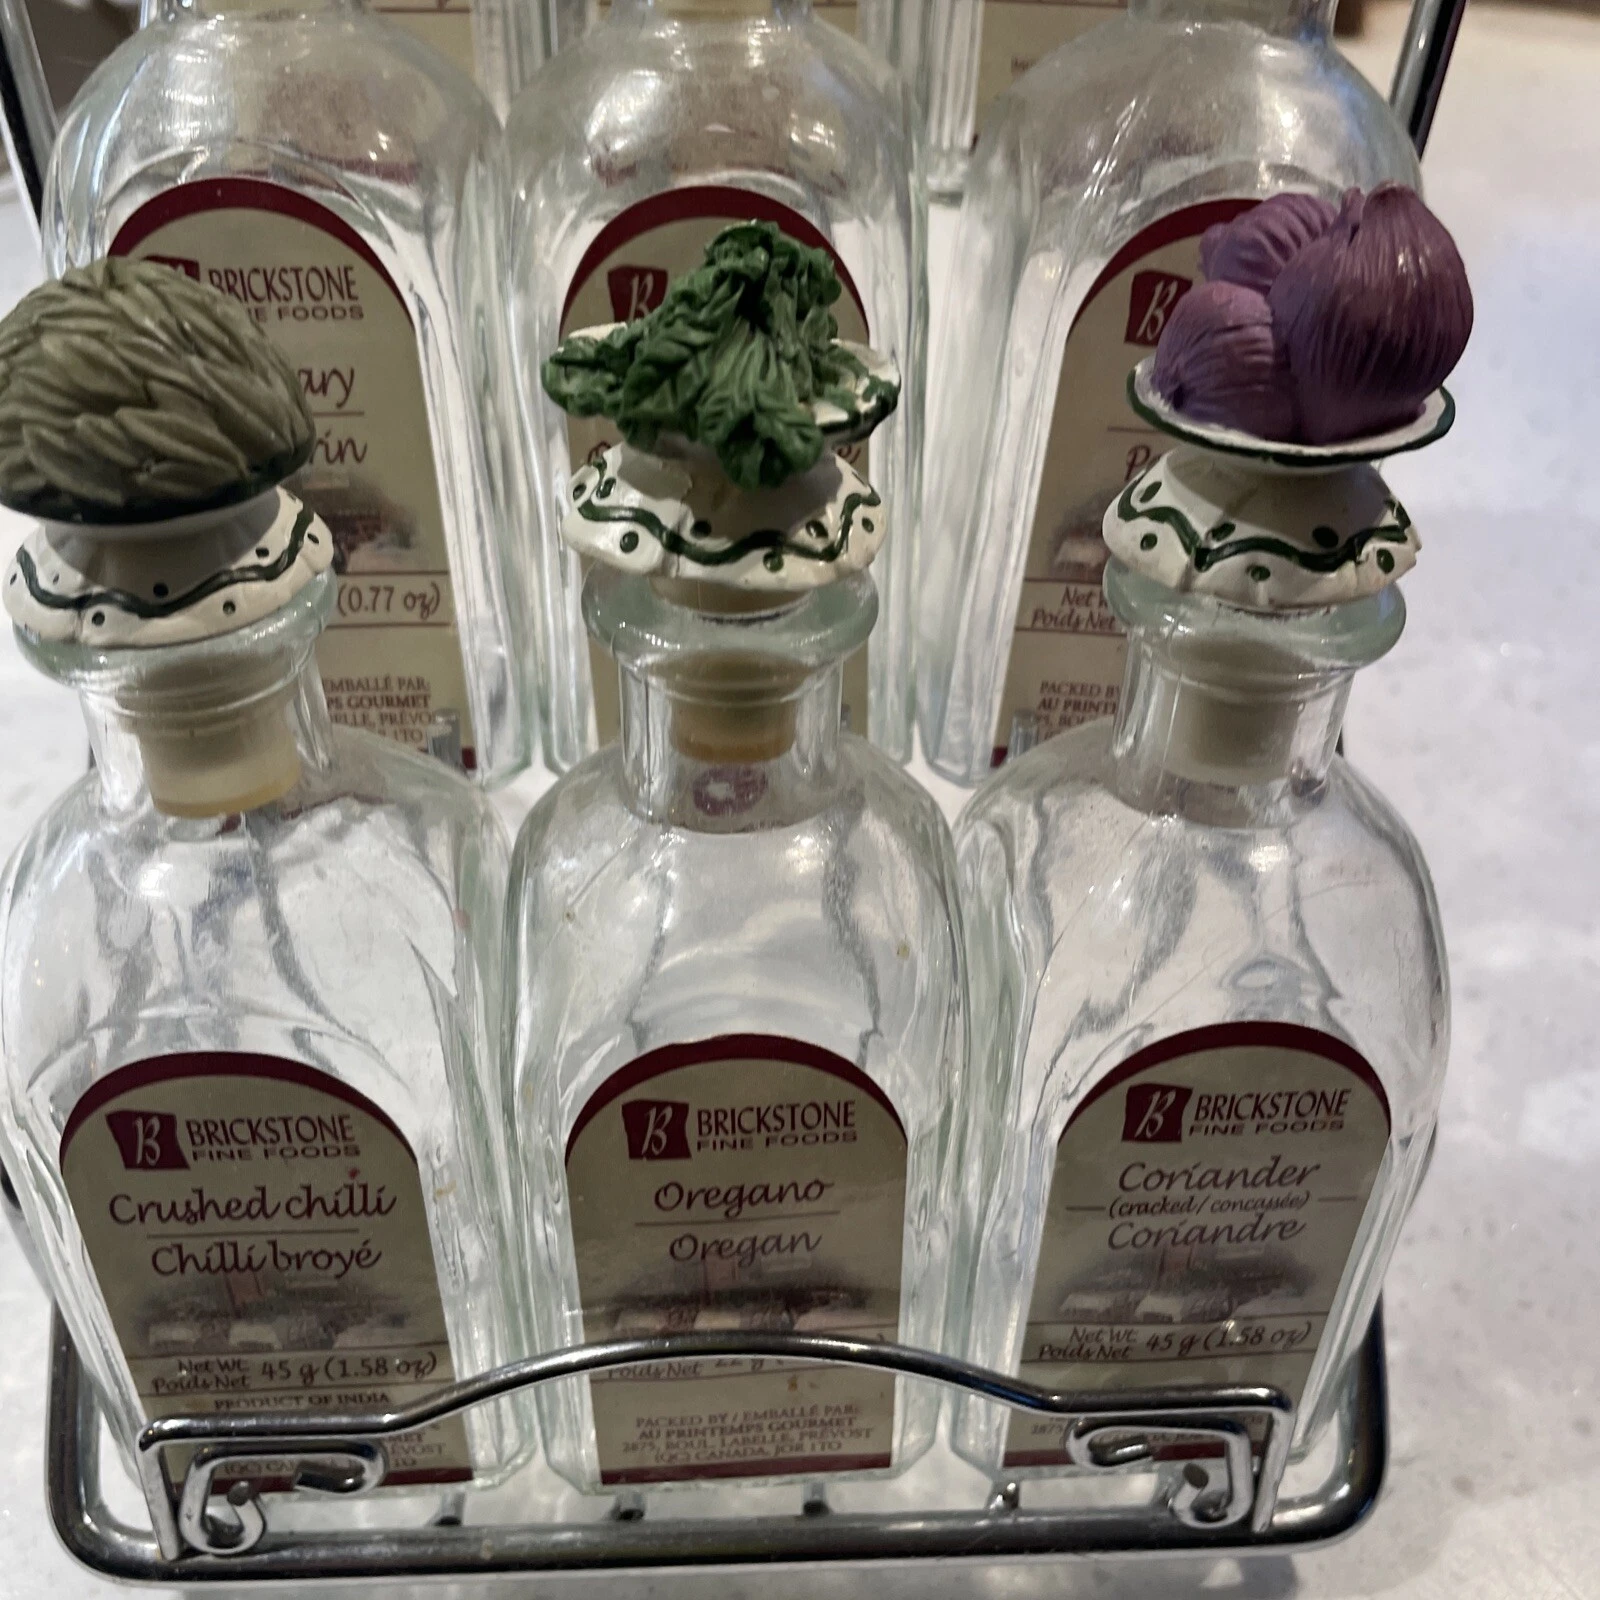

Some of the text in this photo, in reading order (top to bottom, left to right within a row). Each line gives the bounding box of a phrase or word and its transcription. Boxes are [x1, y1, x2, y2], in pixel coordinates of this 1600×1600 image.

[208, 266, 359, 302] BRICKSTONE
[278, 306, 364, 321] FOODS
[337, 581, 441, 620] (0.77 oz)
[1061, 585, 1094, 608] Net
[1085, 609, 1116, 632] Net
[1040, 681, 1100, 696] PACKED
[697, 1101, 856, 1137] BRICKSTONE
[1194, 1089, 1351, 1121] BRICKSTONE
[186, 1114, 354, 1146] BRICKSTONE
[697, 1131, 858, 1152] FINE FOODS
[1188, 1119, 1344, 1137] FINE FOODS
[193, 1144, 361, 1161] FINE FOODS
[1119, 1155, 1321, 1192] Coriander
[109, 1183, 397, 1225] Crushed chilli
[654, 1179, 835, 1220] Oregano
[1108, 1214, 1306, 1250] Coriandre
[151, 1240, 382, 1278] Chilli broyé
[669, 1231, 822, 1268] Oregan
[1038, 1343, 1131, 1362] Poids Net
[1069, 1326, 1102, 1344] Net
[1146, 1330, 1175, 1351] 45
[1178, 1333, 1200, 1357] g
[1202, 1324, 1265, 1350] (1.58
[1270, 1320, 1312, 1349] oz)
[178, 1359, 210, 1373] Net
[261, 1359, 291, 1380] 45
[300, 1363, 319, 1386] g
[324, 1356, 388, 1381] (1.58
[396, 1350, 437, 1379] oz)
[152, 1374, 249, 1396] Poids Net
[214, 1392, 390, 1409] PRODUCT OF INDIA
[636, 1415, 703, 1428] PACKED
[743, 1403, 818, 1420] EMBALLÉ
[666, 1422, 763, 1438] PRINTEMPS
[768, 1416, 857, 1431] GOURMET
